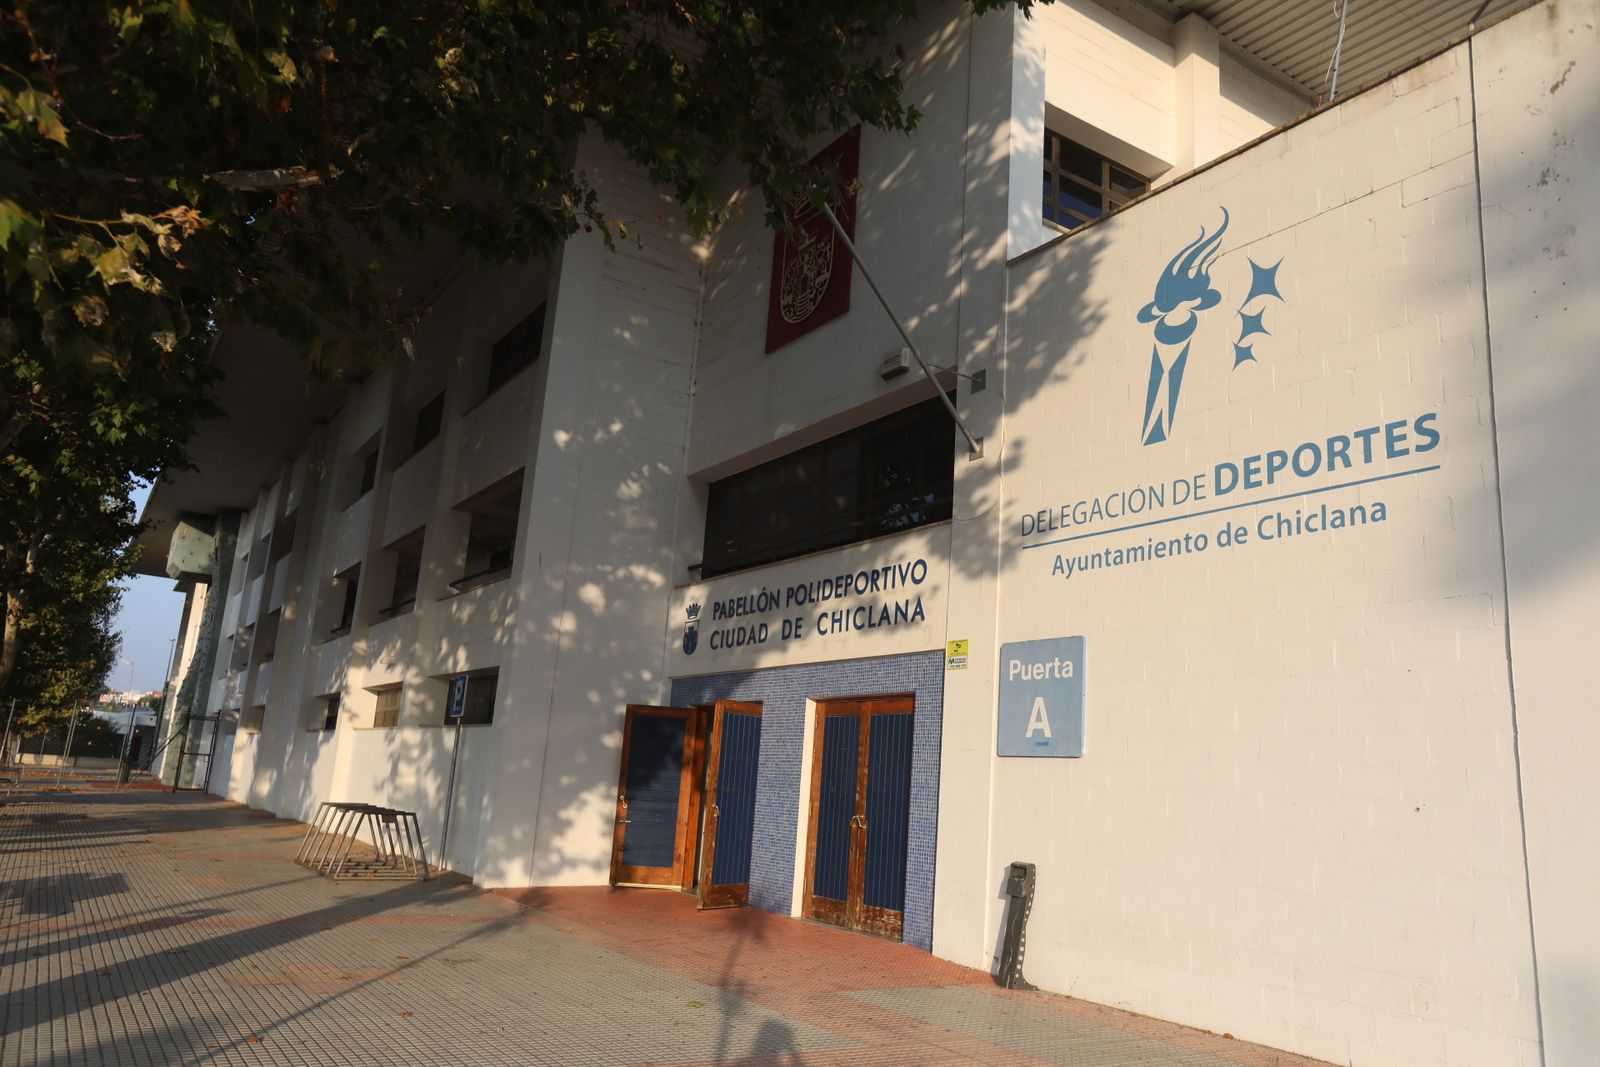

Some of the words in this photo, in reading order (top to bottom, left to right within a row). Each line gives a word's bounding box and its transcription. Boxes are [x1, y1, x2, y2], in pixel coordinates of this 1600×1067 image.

[1021, 483, 1165, 537] DELEGACIÓN
[1172, 473, 1207, 506] DE
[1213, 412, 1441, 497] DEPORTES
[1051, 533, 1209, 580] Ayuntamiento
[1216, 521, 1249, 549] de
[1256, 501, 1388, 541] Chiclana
[712, 587, 780, 620] PABELLÓN
[786, 558, 928, 608] POLIDEPORTIVO
[709, 622, 769, 650] CIUDAD
[781, 616, 804, 640] DE
[816, 596, 926, 636] CHICLANA
[1009, 657, 1073, 681] Puerta
[1025, 696, 1052, 738] A
